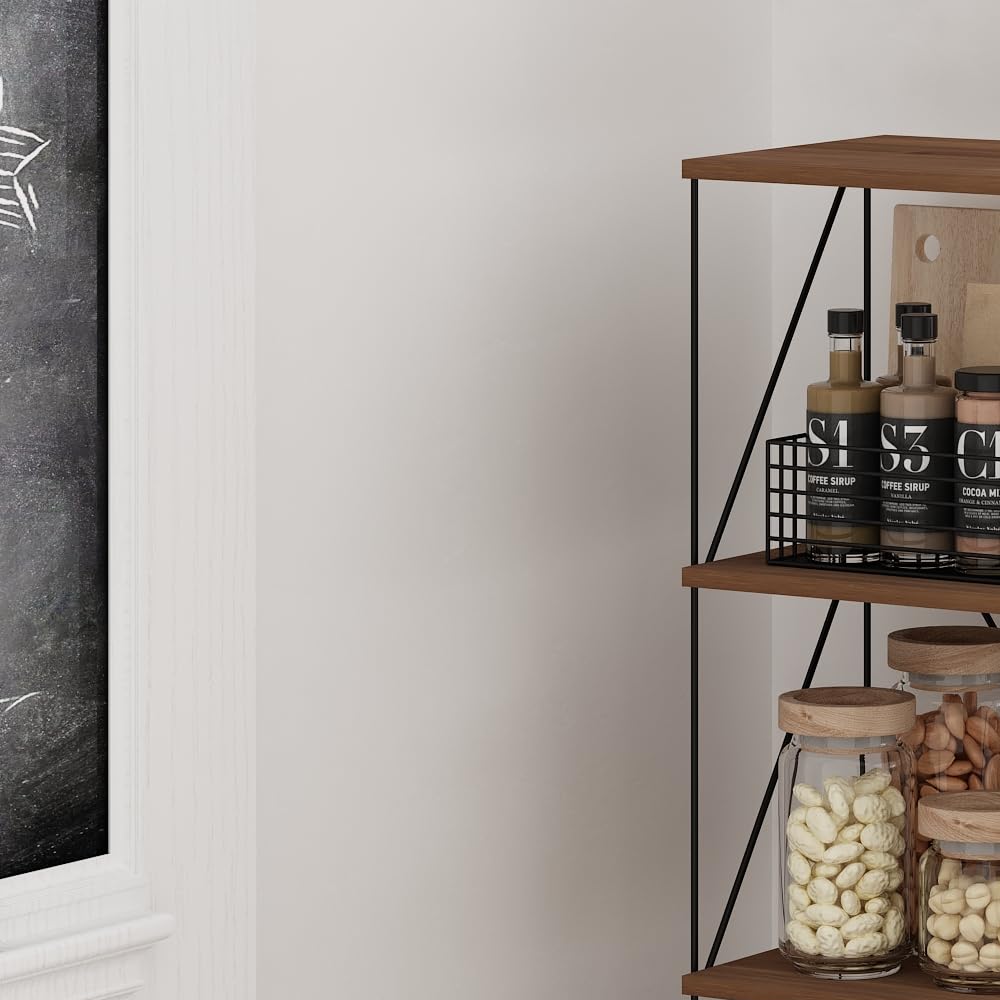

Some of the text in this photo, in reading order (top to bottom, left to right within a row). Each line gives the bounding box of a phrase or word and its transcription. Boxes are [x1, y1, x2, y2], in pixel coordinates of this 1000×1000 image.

[808, 418, 854, 468] S1
[880, 422, 931, 473] S3
[808, 474, 856, 486] COFFEE SIRUP
[881, 479, 930, 492] COFFEE SIRUP
[962, 486, 987, 498] COCOA
